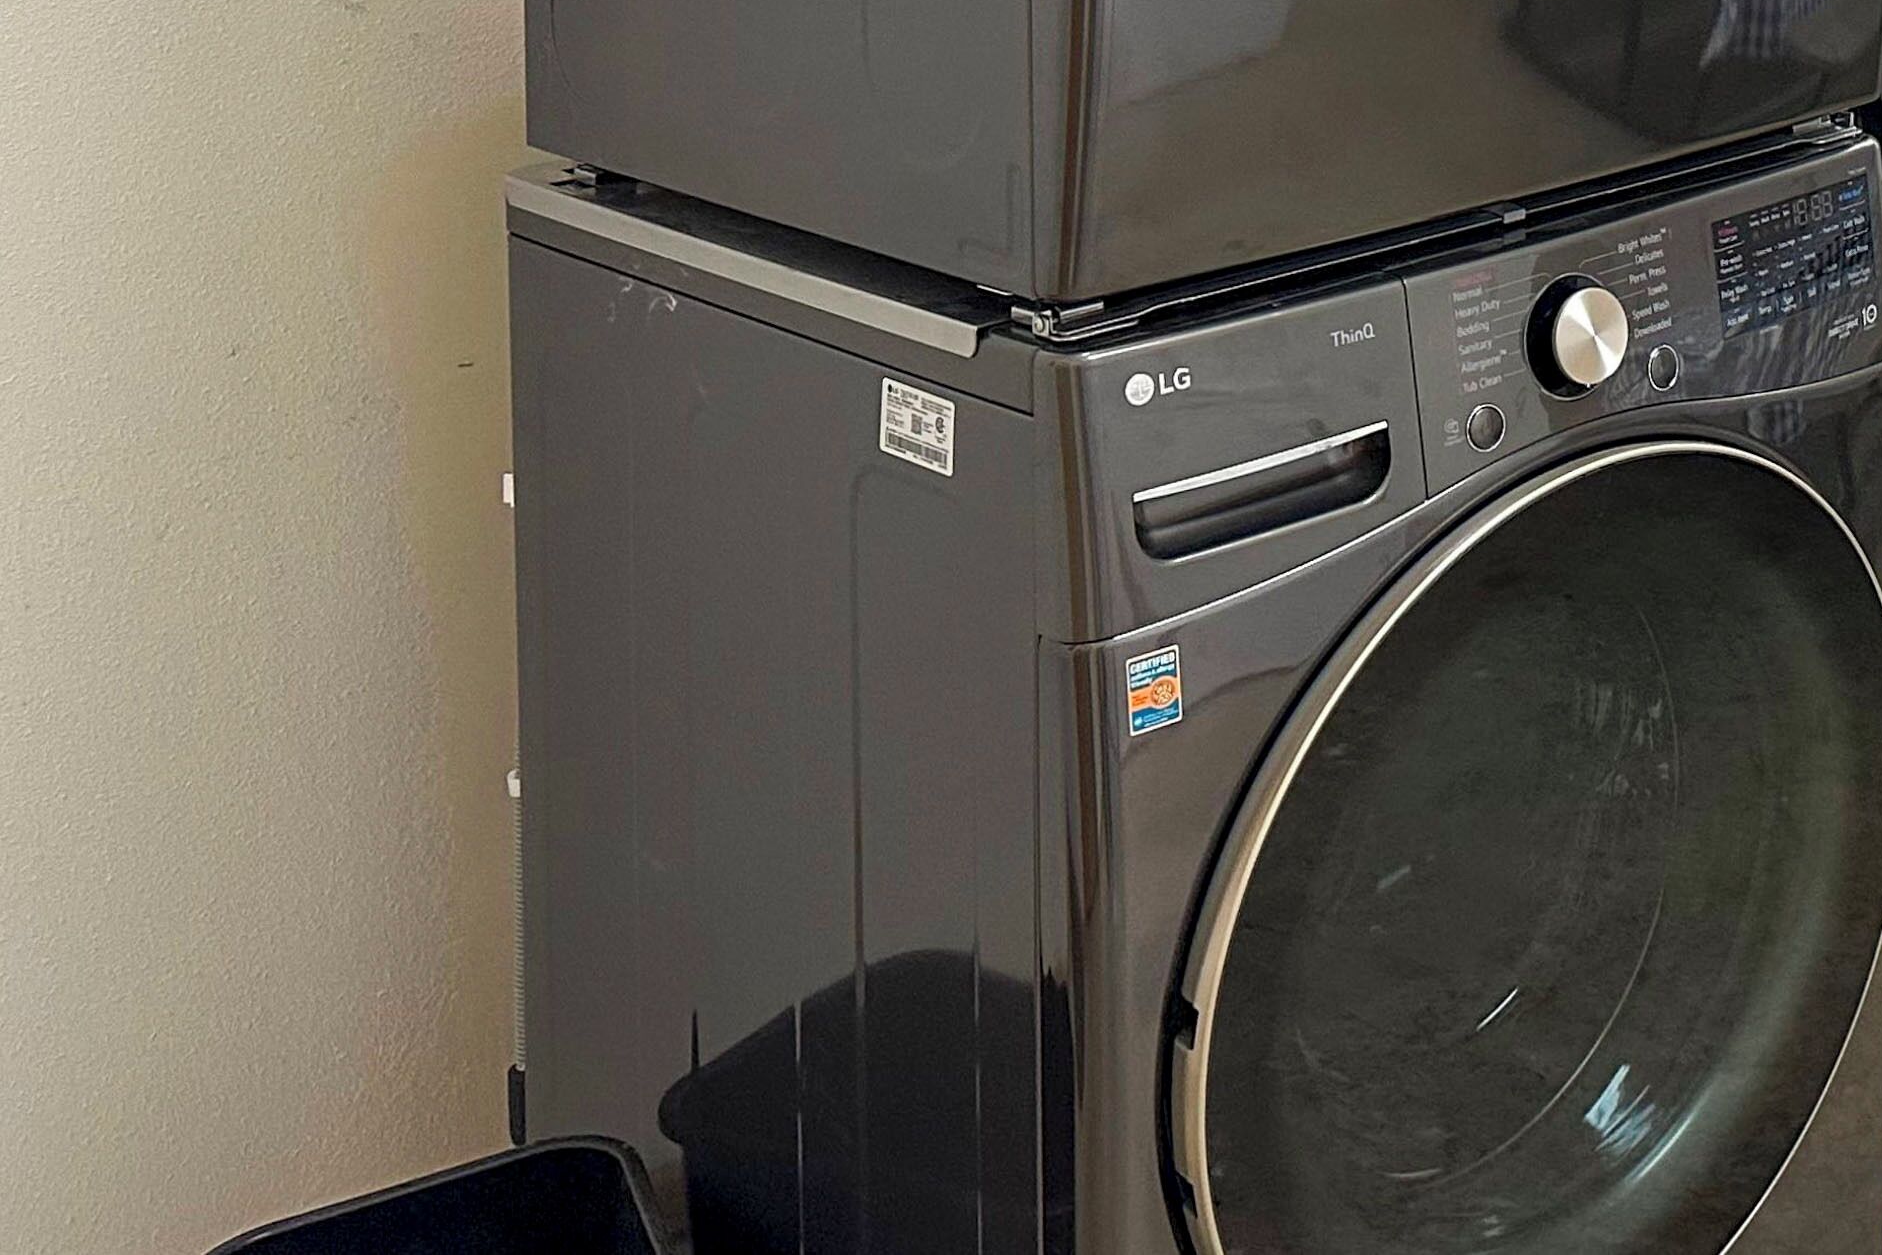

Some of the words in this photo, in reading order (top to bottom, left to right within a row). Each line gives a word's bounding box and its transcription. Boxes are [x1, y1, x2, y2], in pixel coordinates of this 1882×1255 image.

[1861, 304, 1877, 326] 10
[1330, 323, 1376, 347] ThinQ
[1158, 367, 1191, 395] LG
